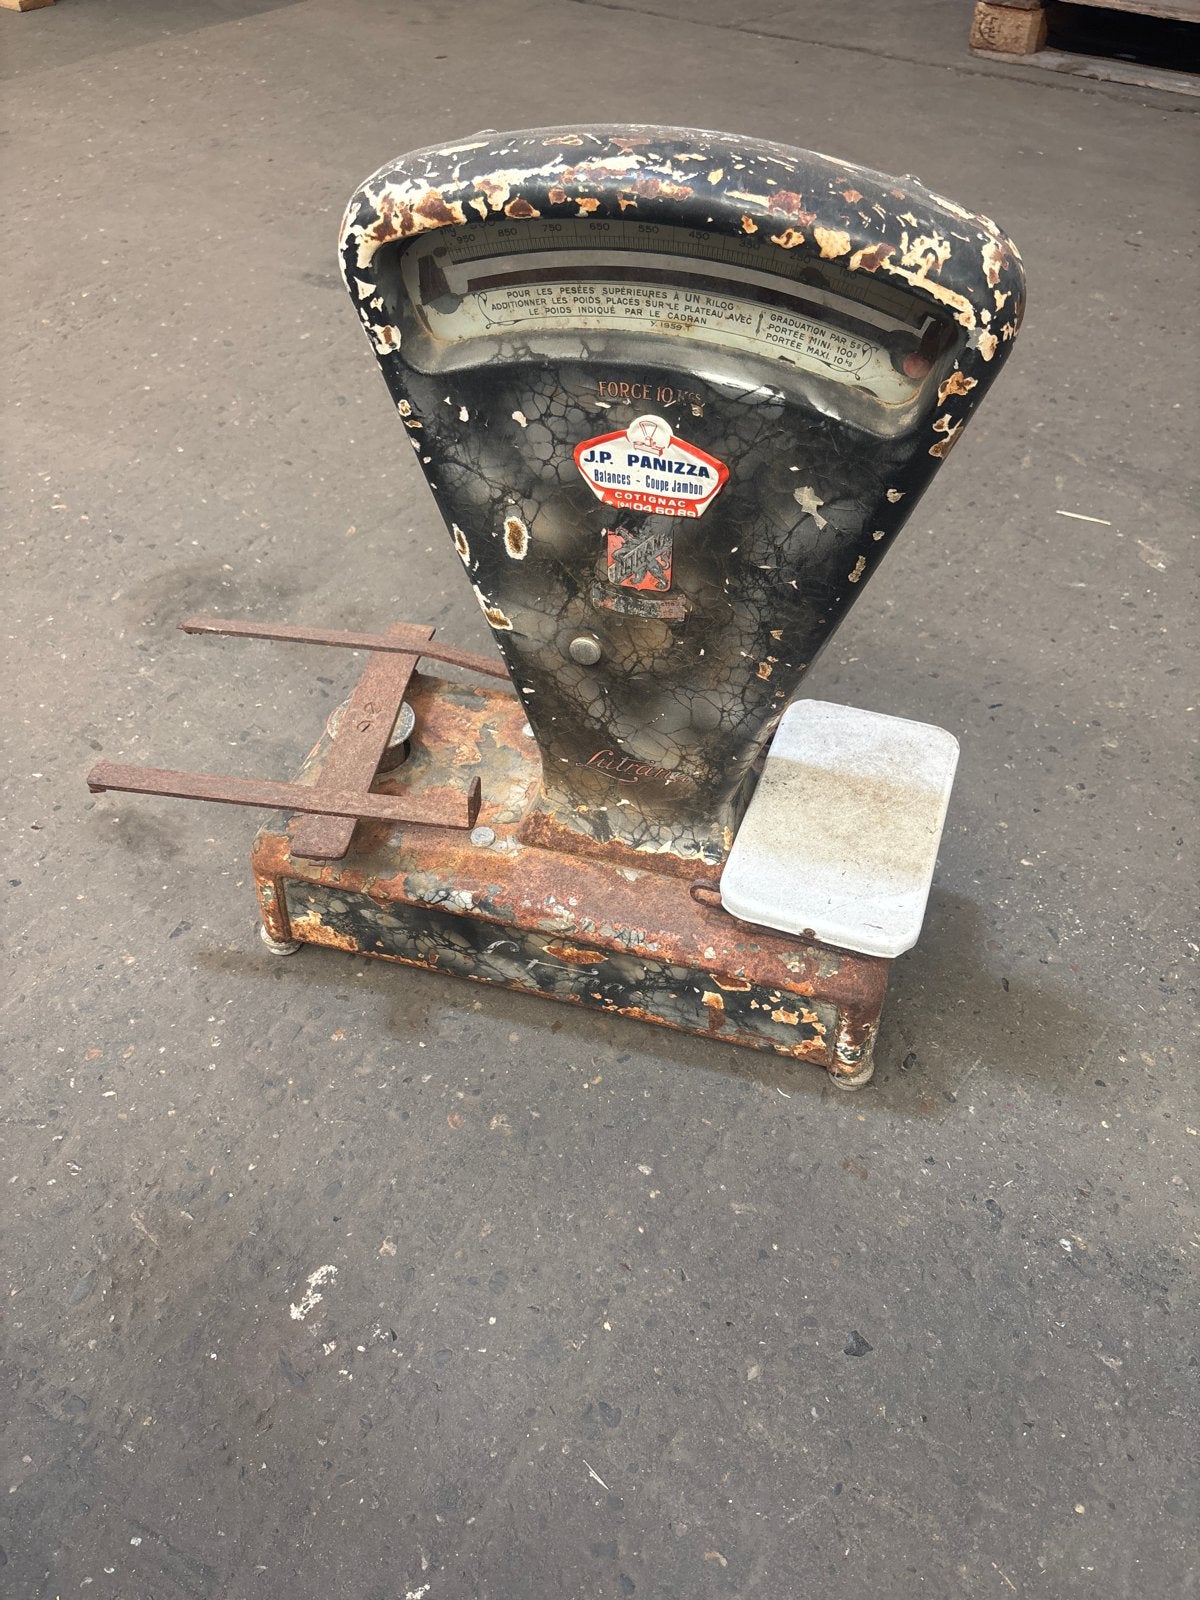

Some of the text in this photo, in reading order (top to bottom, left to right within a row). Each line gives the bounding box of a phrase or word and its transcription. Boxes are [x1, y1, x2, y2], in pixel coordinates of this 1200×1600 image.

[498, 227, 518, 237] 850
[543, 223, 562, 232] 750
[589, 222, 610, 232] 650
[638, 224, 659, 234] 550
[689, 231, 710, 241] 450
[491, 296, 752, 325] ADDITIONNER LES POIDS PLACÉS SUR LE PLATEAU AVEC
[506, 285, 734, 311] POUR LES PESÉES SUPÉRIEURES À UN KILOG
[528, 304, 707, 325] LE POIDS INDIQUÉ PAR LE CADRAN
[767, 323, 805, 341] PORTÉE
[770, 313, 827, 337] GRADUATION
[829, 333, 847, 345] PAR
[765, 332, 803, 350] PORTÉE
[806, 345, 831, 361] MAXI.
[598, 381, 653, 401] FORCE
[657, 386, 674, 403] 10
[583, 450, 711, 479] J.P. PANIZZA
[594, 468, 631, 486] Balances
[645, 474, 669, 493] Coupe
[671, 479, 703, 496] Jambon
[614, 491, 686, 508] COTIGNAC
